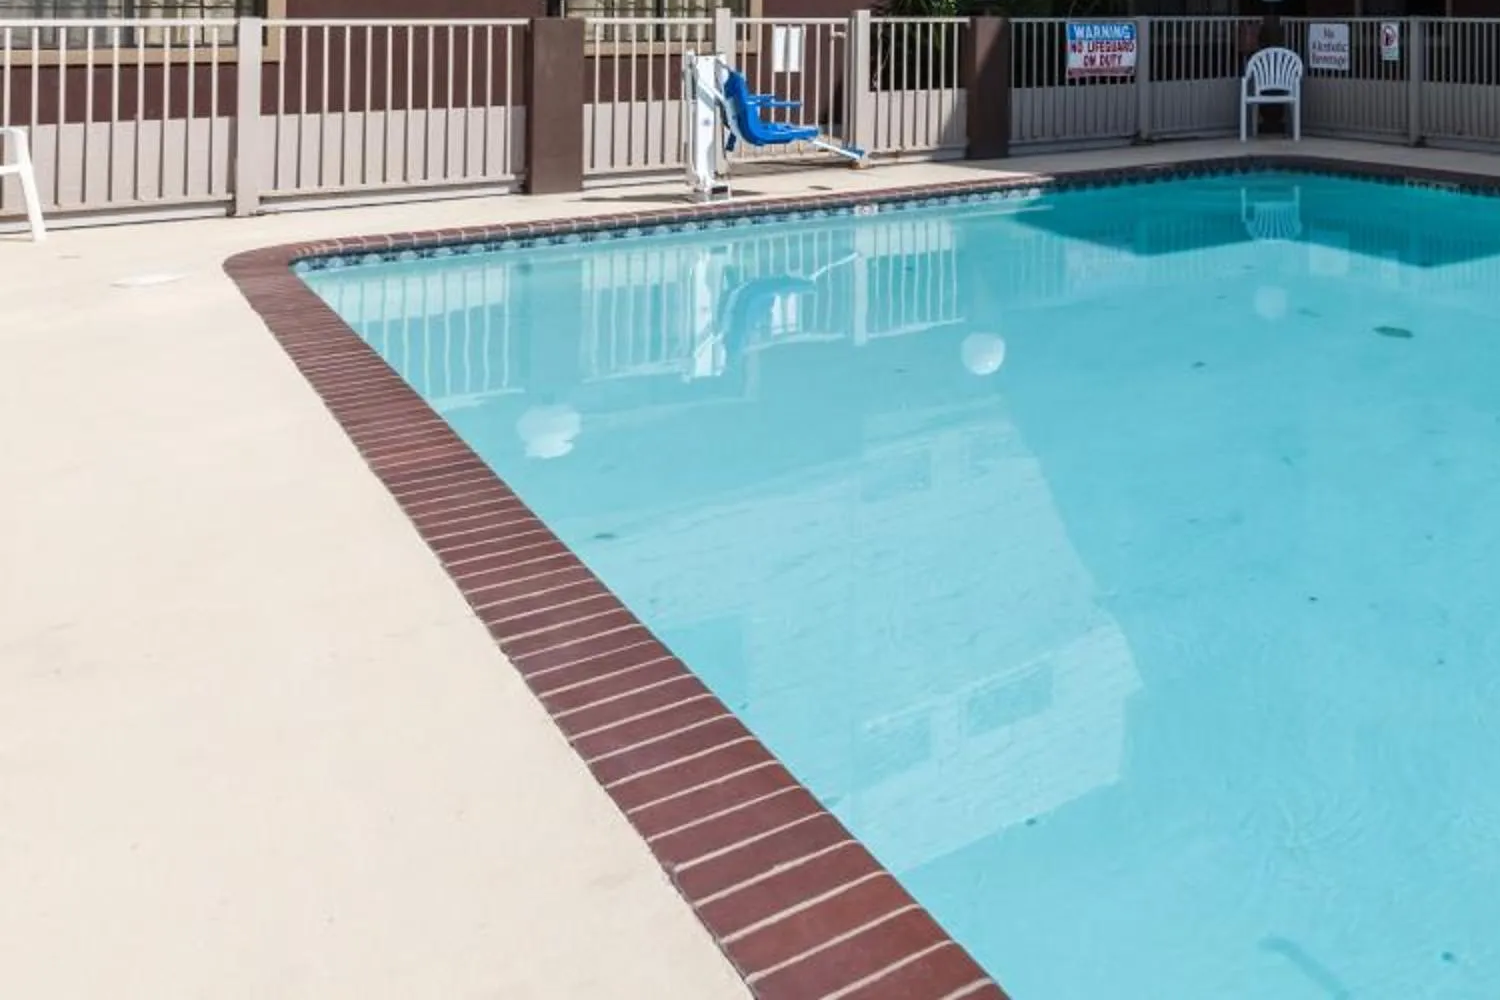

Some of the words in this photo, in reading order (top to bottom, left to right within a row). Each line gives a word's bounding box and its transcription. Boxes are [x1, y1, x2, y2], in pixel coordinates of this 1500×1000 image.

[1073, 25, 1131, 39] WARNING
[1070, 41, 1083, 53] NO
[1088, 41, 1135, 53] LIFEGUARD
[1084, 53, 1096, 66] ON
[1100, 53, 1122, 66] DUTY
